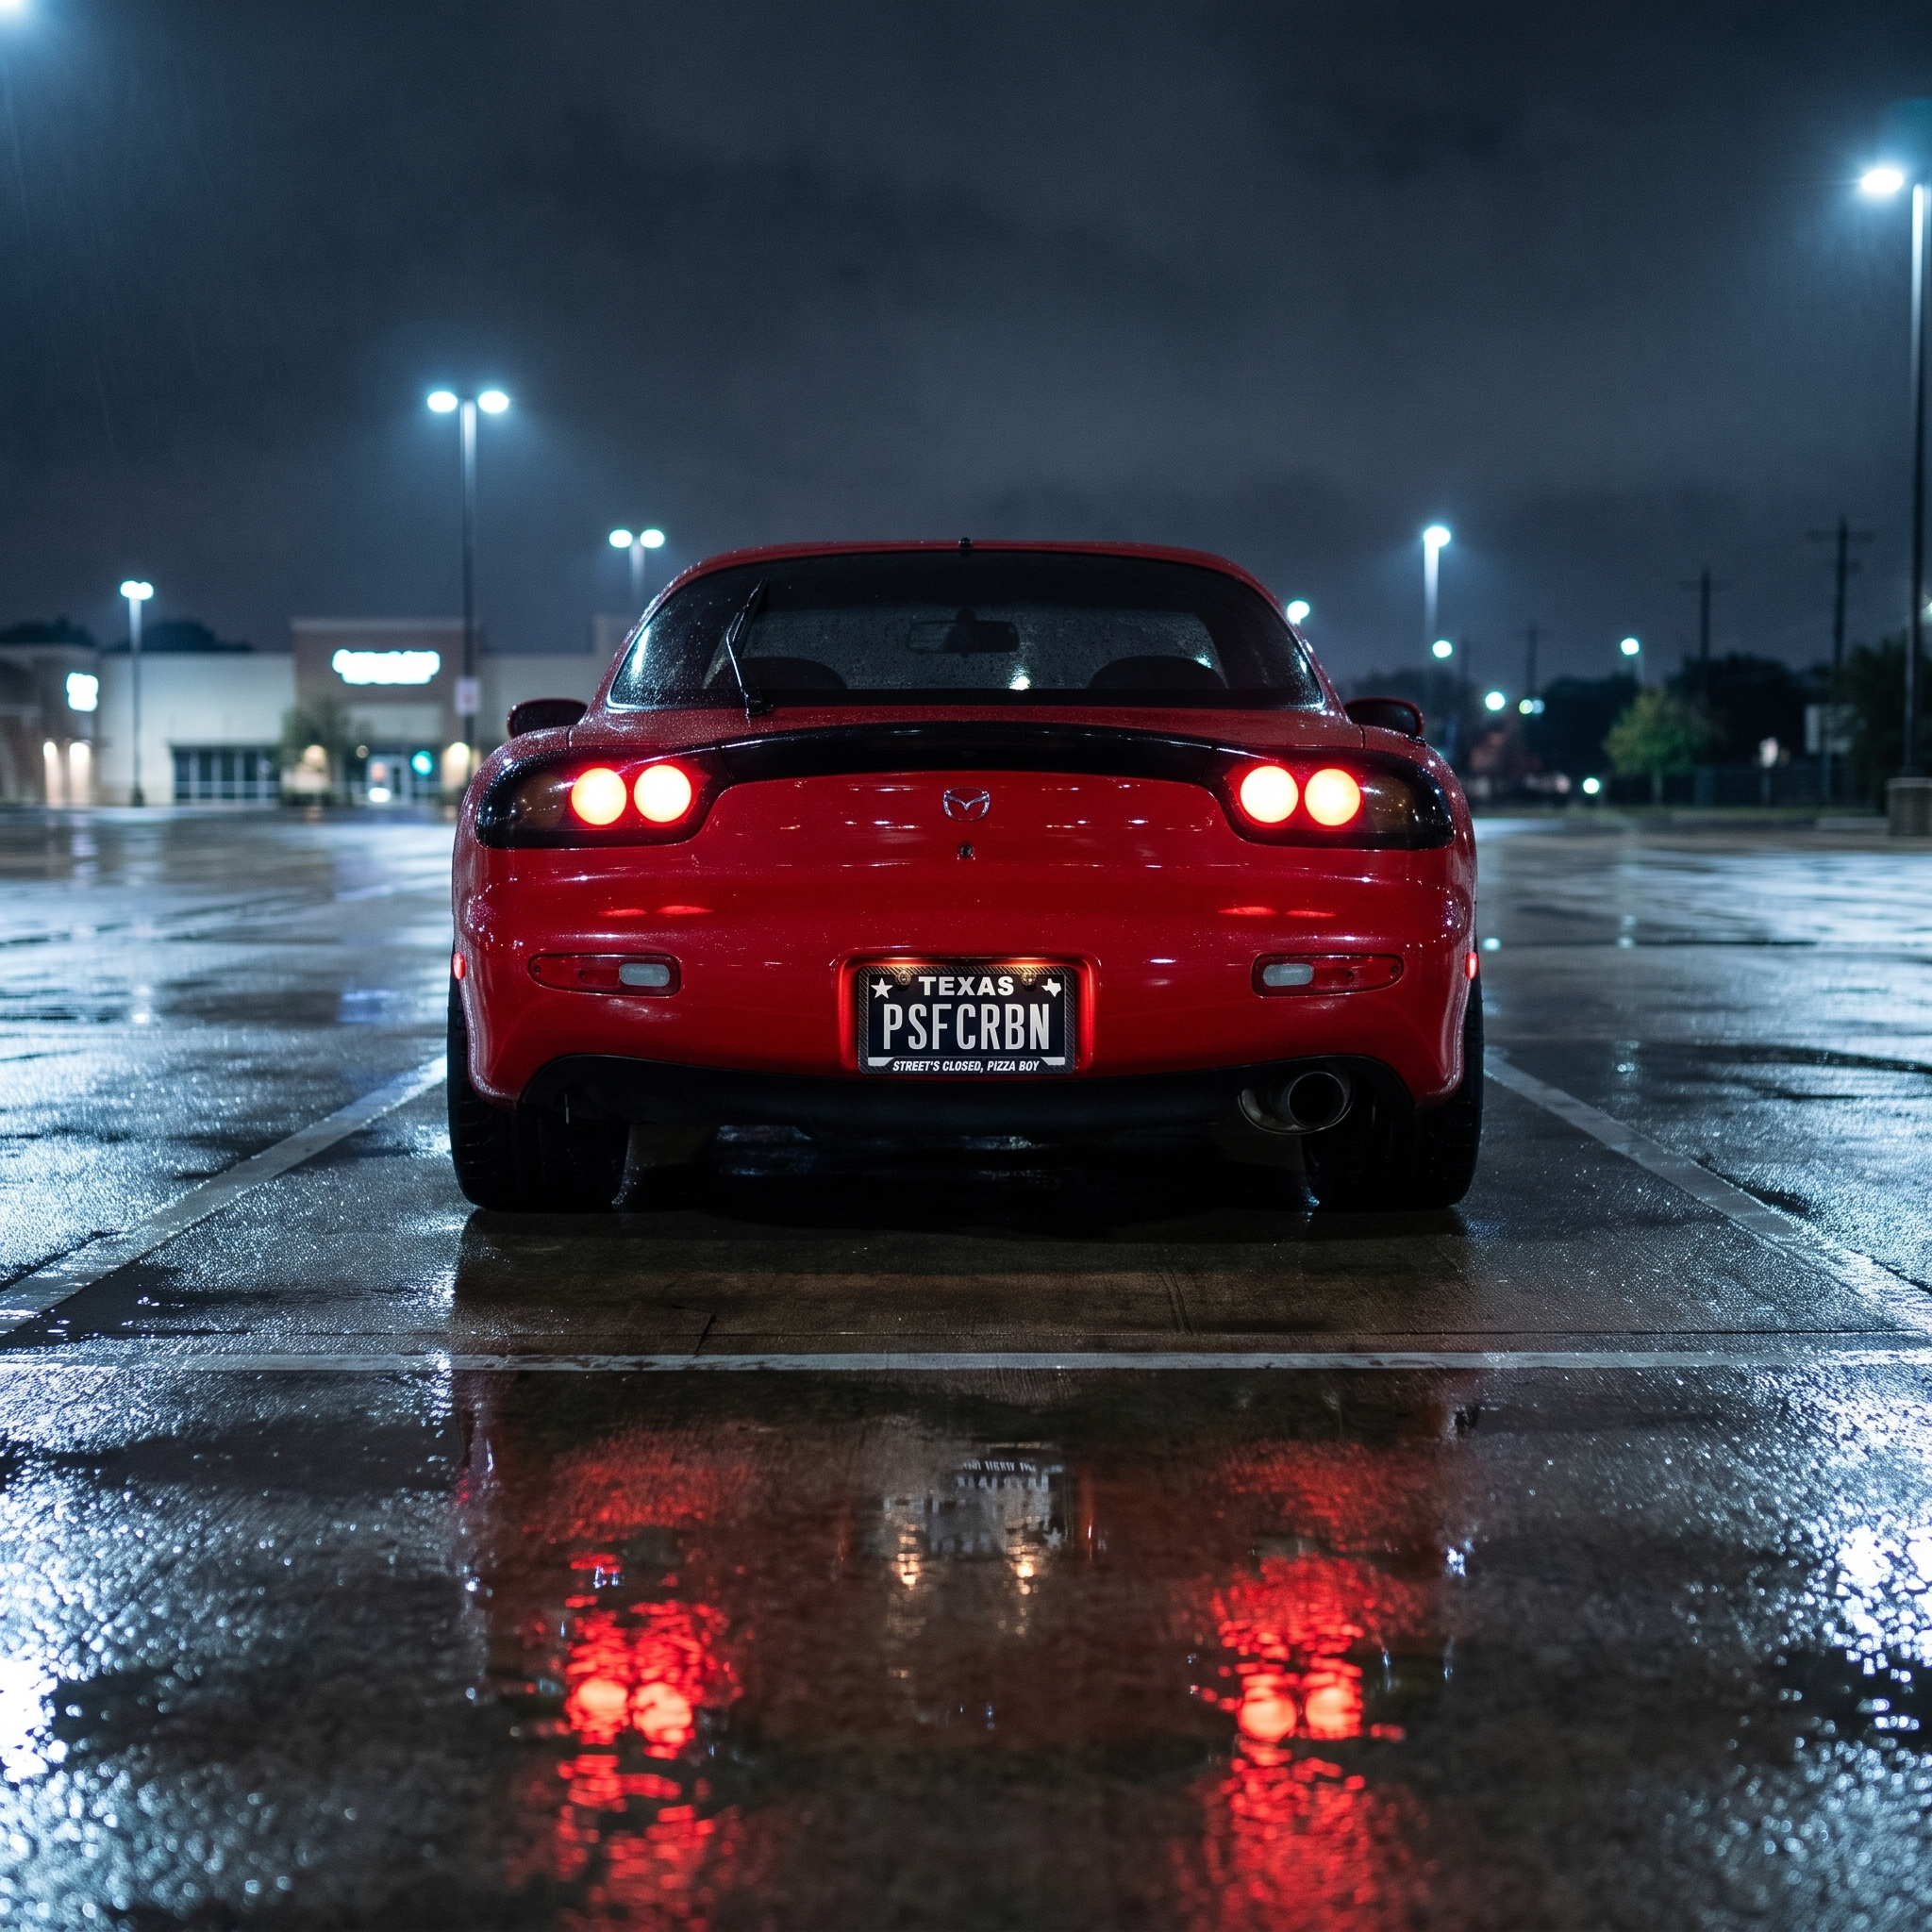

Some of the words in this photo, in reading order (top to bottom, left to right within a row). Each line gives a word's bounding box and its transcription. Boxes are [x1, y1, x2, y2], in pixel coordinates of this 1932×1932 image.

[918, 976, 1014, 996] TEXAS
[883, 1003, 1050, 1050] PSFCRBN
[892, 1060, 940, 1072] STREET'S
[941, 1060, 984, 1073] CLOSED,
[987, 1060, 1016, 1072] PIZZA
[1018, 1060, 1040, 1072] BOY
